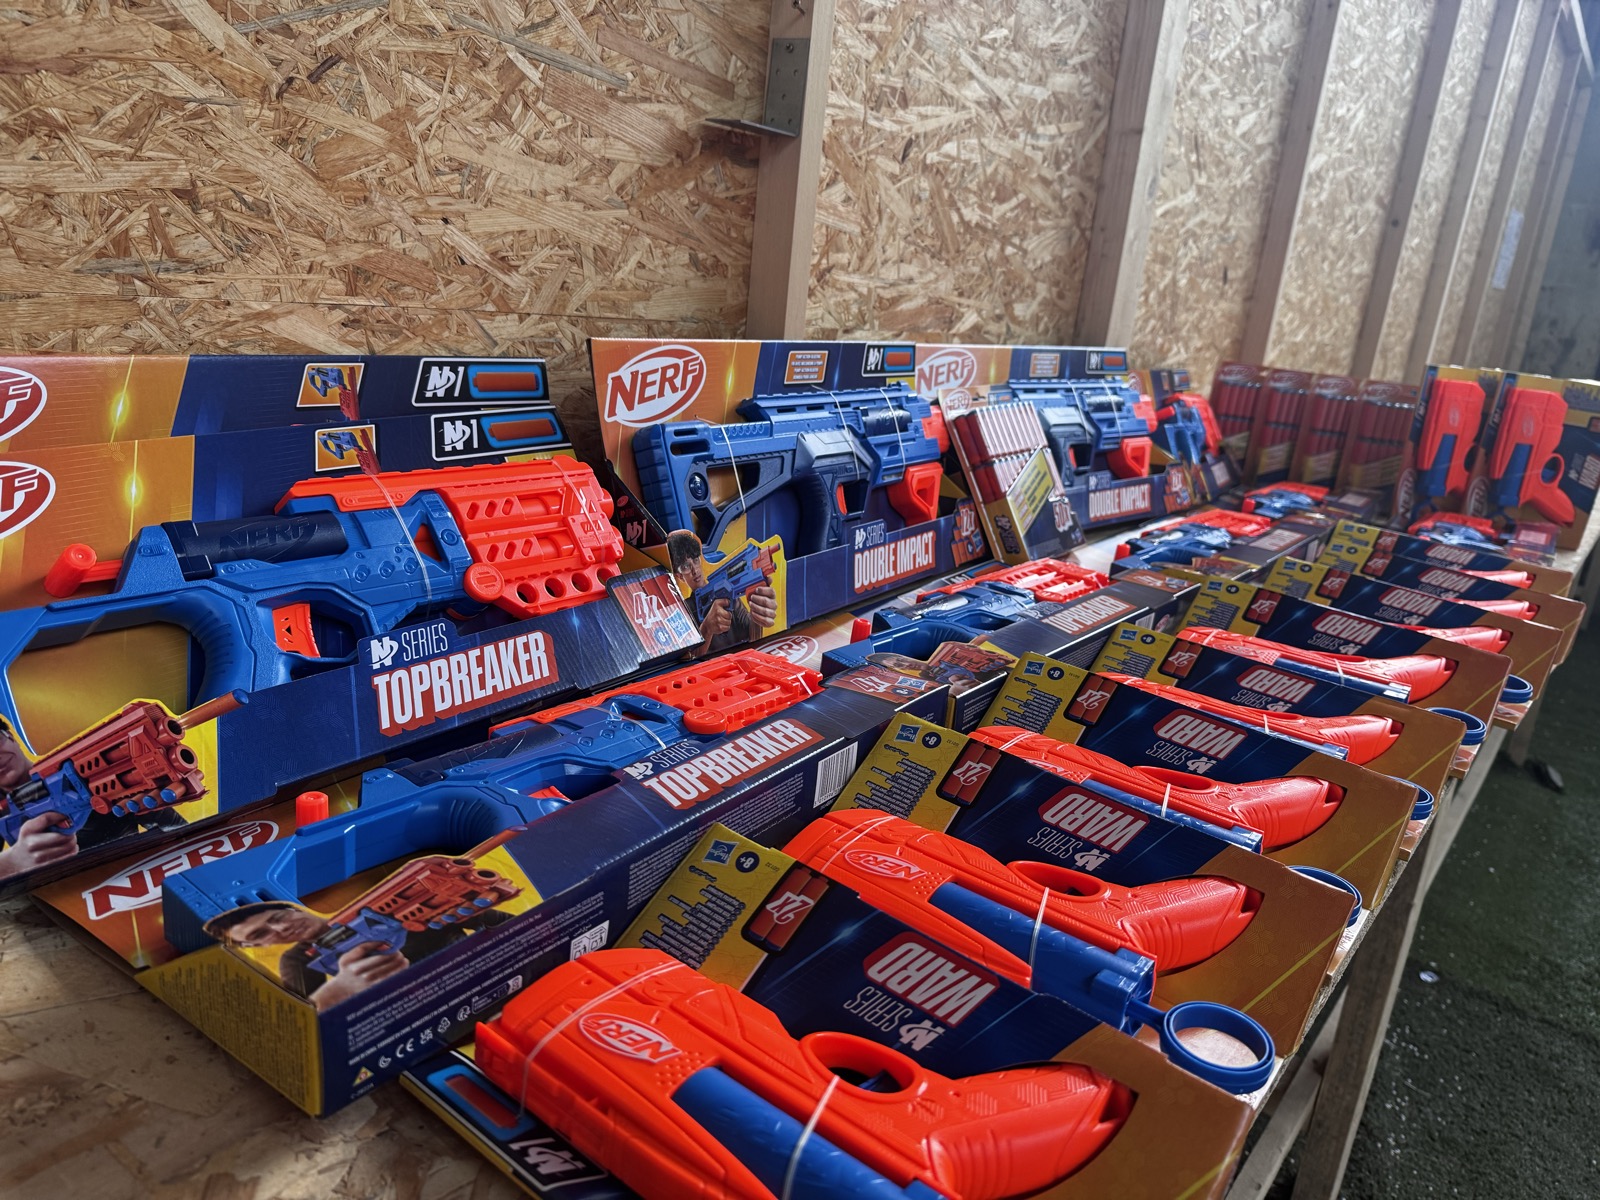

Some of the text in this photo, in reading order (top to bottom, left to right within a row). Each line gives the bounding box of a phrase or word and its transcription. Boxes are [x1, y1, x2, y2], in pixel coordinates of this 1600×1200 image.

[607, 356, 701, 418] NERF
[916, 356, 973, 395] NERF
[1089, 484, 1149, 518] DOUBLE IMPACT
[867, 523, 885, 546] SERIES
[854, 531, 934, 588] DOUBLE IMPACT
[1426, 545, 1476, 565] WARD
[1420, 570, 1477, 593] WARD
[1042, 595, 1130, 634] TOPBREAKER
[1380, 589, 1442, 616] WARD
[401, 623, 449, 662] SERIES
[1307, 633, 1343, 649] SERIES
[1314, 614, 1383, 645] WARD
[374, 631, 549, 730] TOPBREAKER
[1231, 689, 1270, 708] SERIES
[1239, 668, 1315, 703] WARD
[651, 741, 700, 767] SERIES
[925, 735, 937, 745] 8+
[1146, 741, 1192, 765] SERIES
[1157, 714, 1247, 760] WARD
[643, 719, 812, 807] TOPBREAKER
[1042, 793, 1148, 852] WARD
[740, 856, 755, 869] 8+
[1027, 826, 1083, 865] SERIES
[89, 822, 260, 917] NERF
[850, 852, 926, 880] NERF
[867, 942, 996, 1025] WARD
[843, 986, 913, 1032] SERIES
[582, 1019, 681, 1062] NERF
